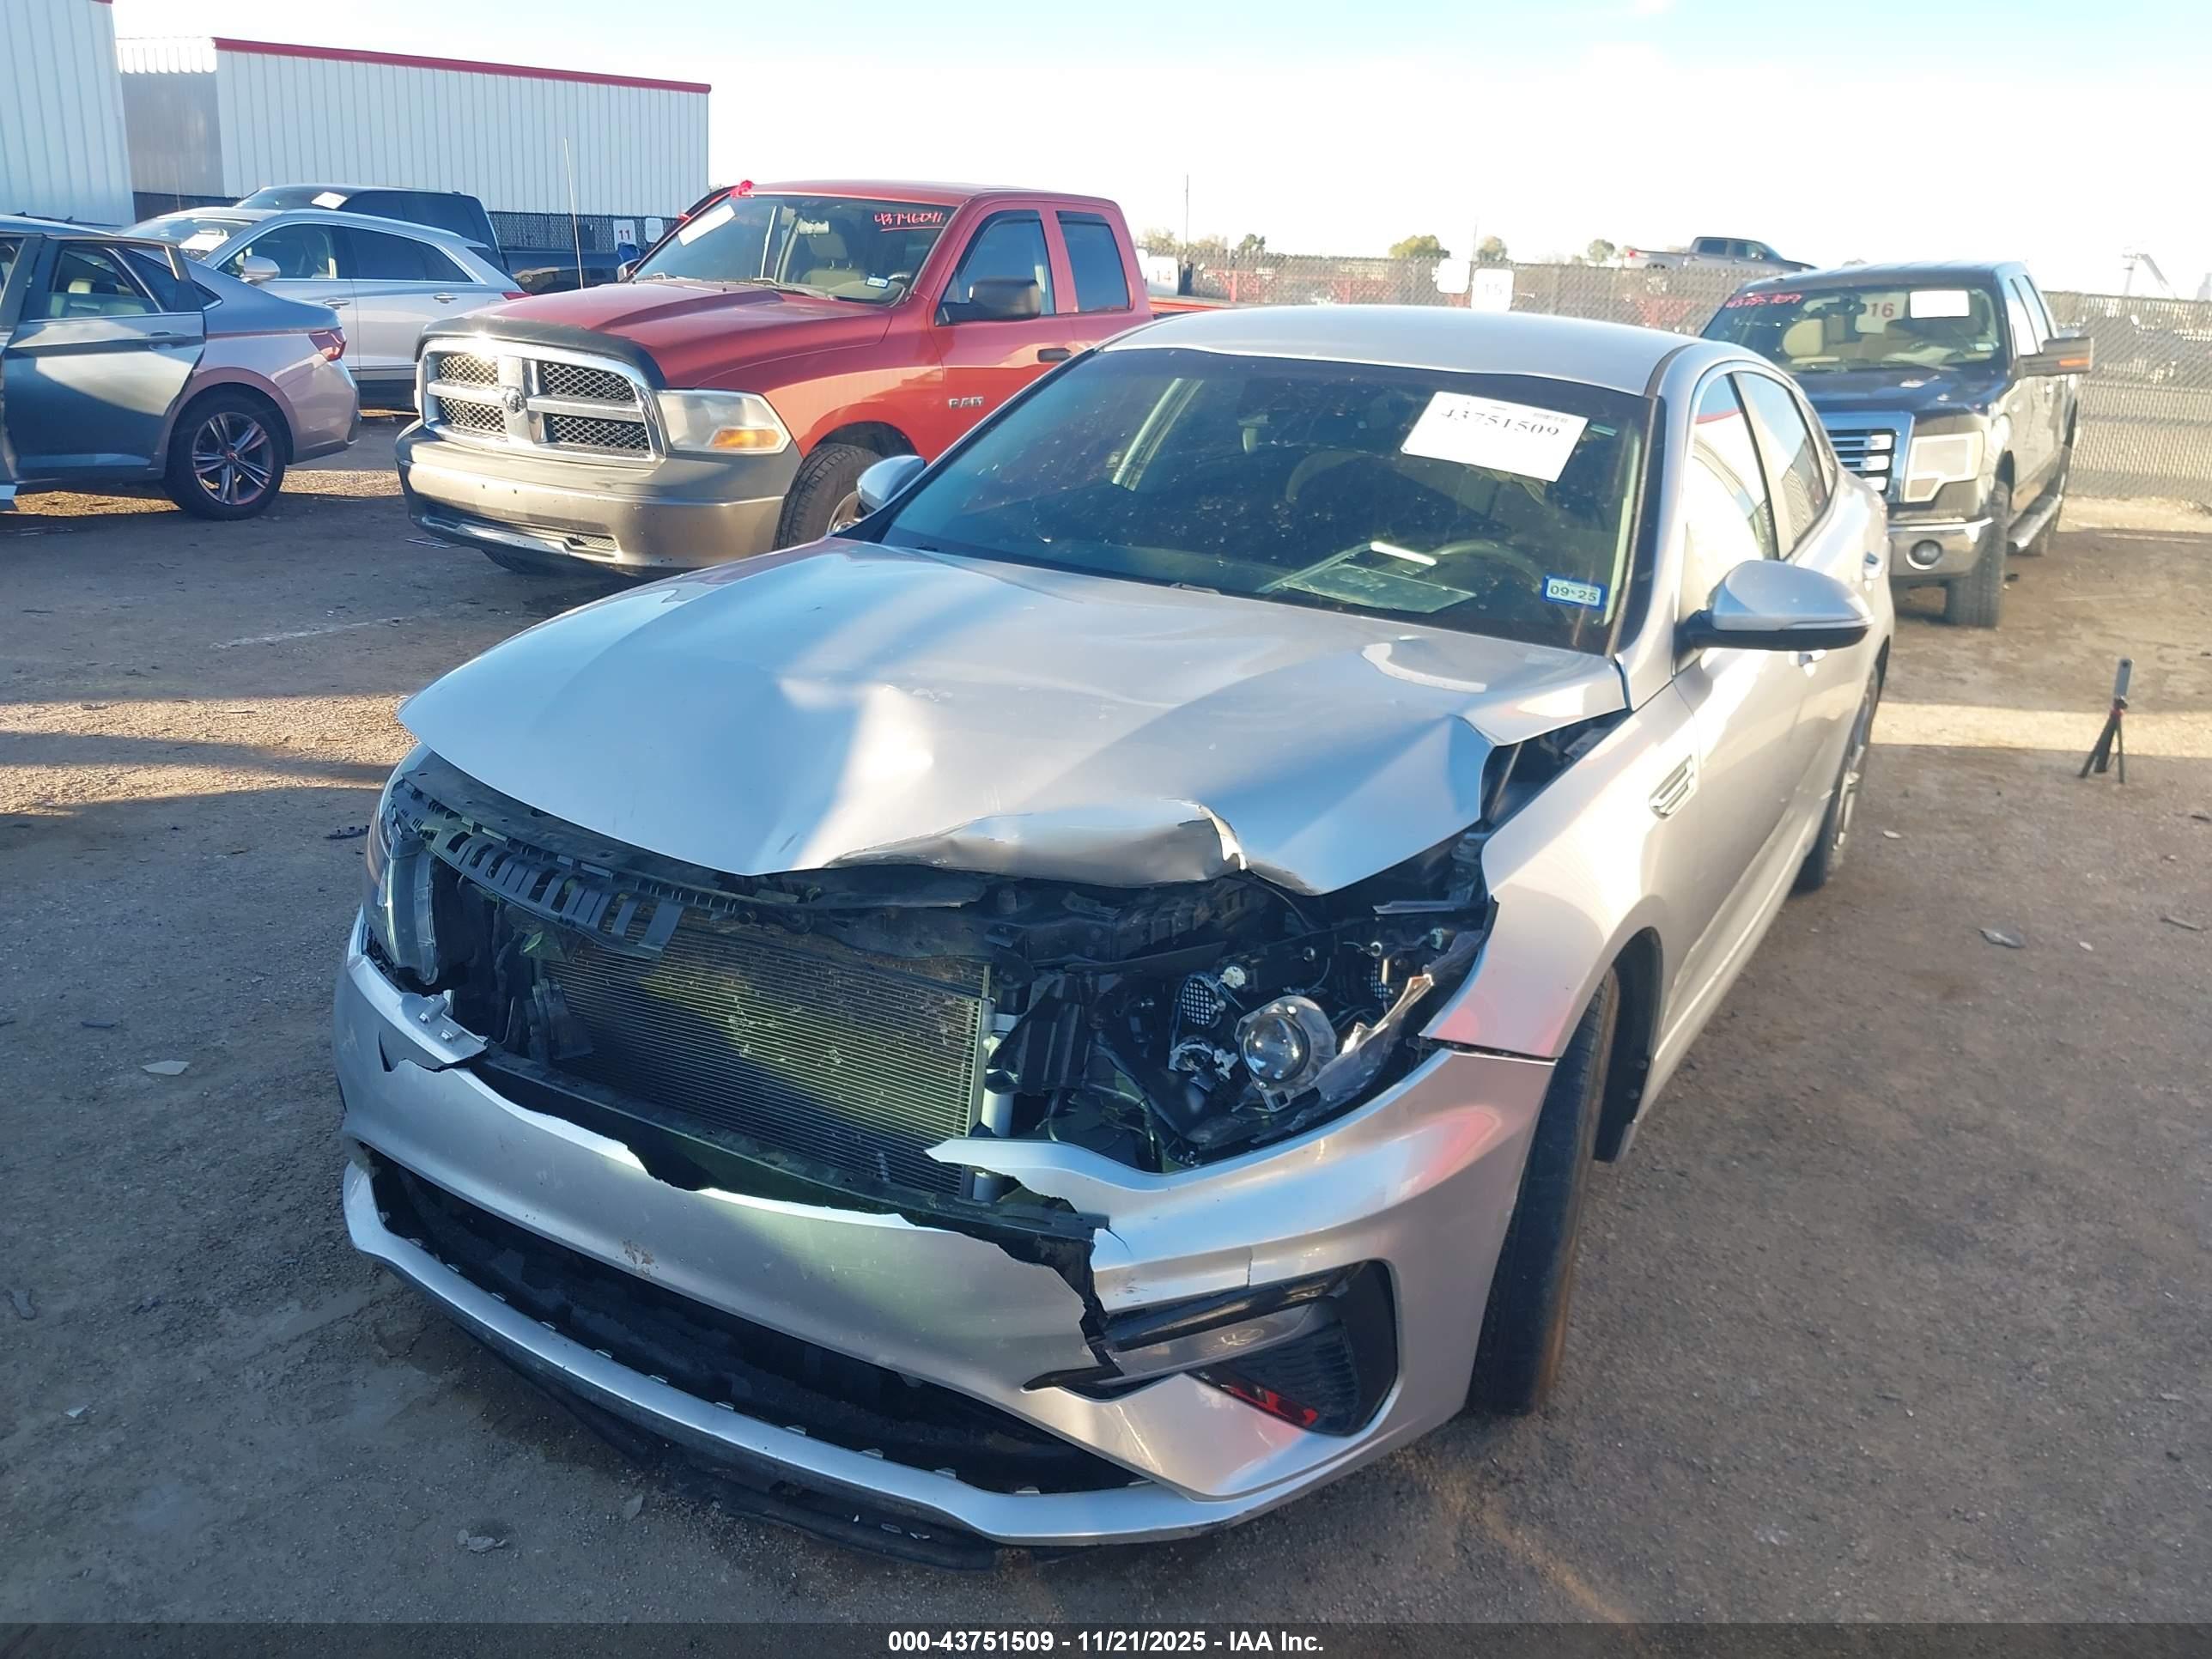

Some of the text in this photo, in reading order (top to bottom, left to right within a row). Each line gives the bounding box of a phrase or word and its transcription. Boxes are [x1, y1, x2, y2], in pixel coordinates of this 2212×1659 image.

[618, 228, 630, 240] 11
[1485, 283, 1503, 296] 15
[1869, 302, 1895, 319] 16
[948, 396, 984, 410] RAM
[1441, 408, 1560, 436] 43751509
